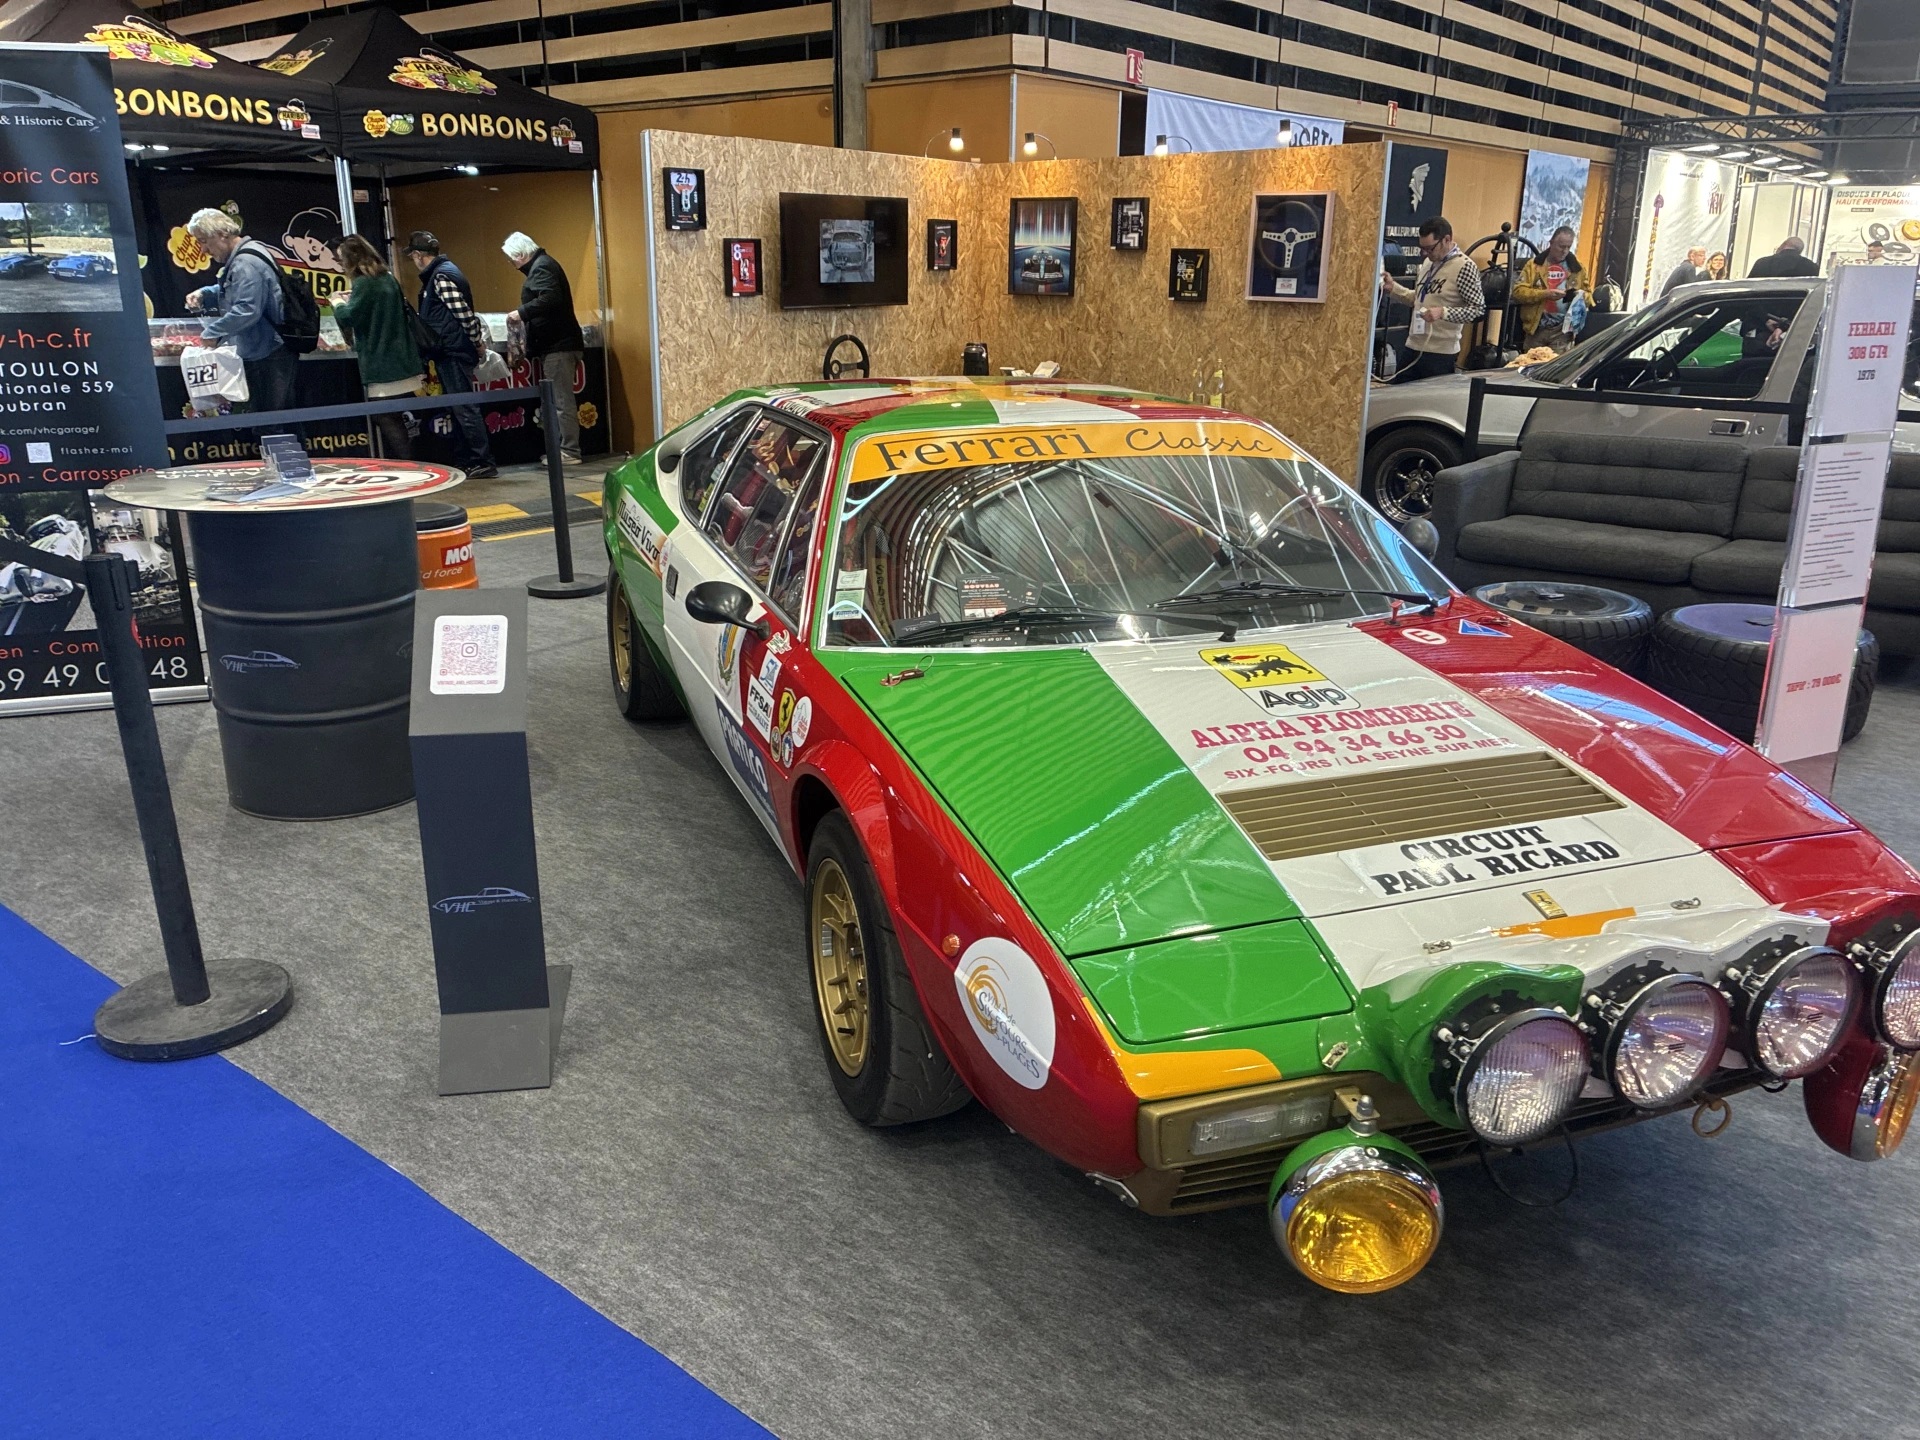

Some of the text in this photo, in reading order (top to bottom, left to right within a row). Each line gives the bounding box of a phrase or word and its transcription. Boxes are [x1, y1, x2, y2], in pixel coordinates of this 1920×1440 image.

[113, 87, 273, 125] BONBONS
[14, 115, 63, 126] Historic
[66, 116, 95, 127] Cars
[421, 112, 548, 143] BONBONS
[0, 167, 99, 184] oric Cars
[1835, 198, 1861, 206] HAUTE
[1836, 190, 1870, 198] DISQUES
[1870, 190, 1881, 198] ET
[175, 230, 194, 262] Chup
[1847, 321, 1897, 337] FERRARI
[1847, 346, 1867, 360] 308
[0, 361, 99, 378] TOULON
[1856, 369, 1876, 381] 1976
[81, 381, 115, 393] 559
[61, 445, 133, 456] flashez-moi
[183, 439, 262, 461] d'autre
[304, 431, 371, 451] arques
[873, 427, 1273, 472] Ferrari Classic
[617, 497, 642, 539] Museo
[640, 525, 661, 561] Vivo
[433, 566, 464, 578] force
[48, 634, 186, 656] Comition
[42, 662, 80, 688] 49
[150, 655, 189, 680] 48
[222, 659, 248, 674] VHC
[749, 685, 769, 716] FFSA
[1257, 684, 1348, 710] Agip
[1190, 700, 1477, 748] ALPHA PLOMBERIE
[1242, 724, 1467, 764] 04 94 34 66 30
[1223, 766, 1257, 781] SIX
[1343, 754, 1373, 765] LA
[1371, 744, 1436, 761] SEYNE
[1437, 740, 1471, 755] SUR
[1477, 735, 1511, 750] MER
[1399, 825, 1553, 862] CIRCUIT
[1369, 840, 1620, 896] PAUL RICARD
[440, 902, 476, 914] VHC
